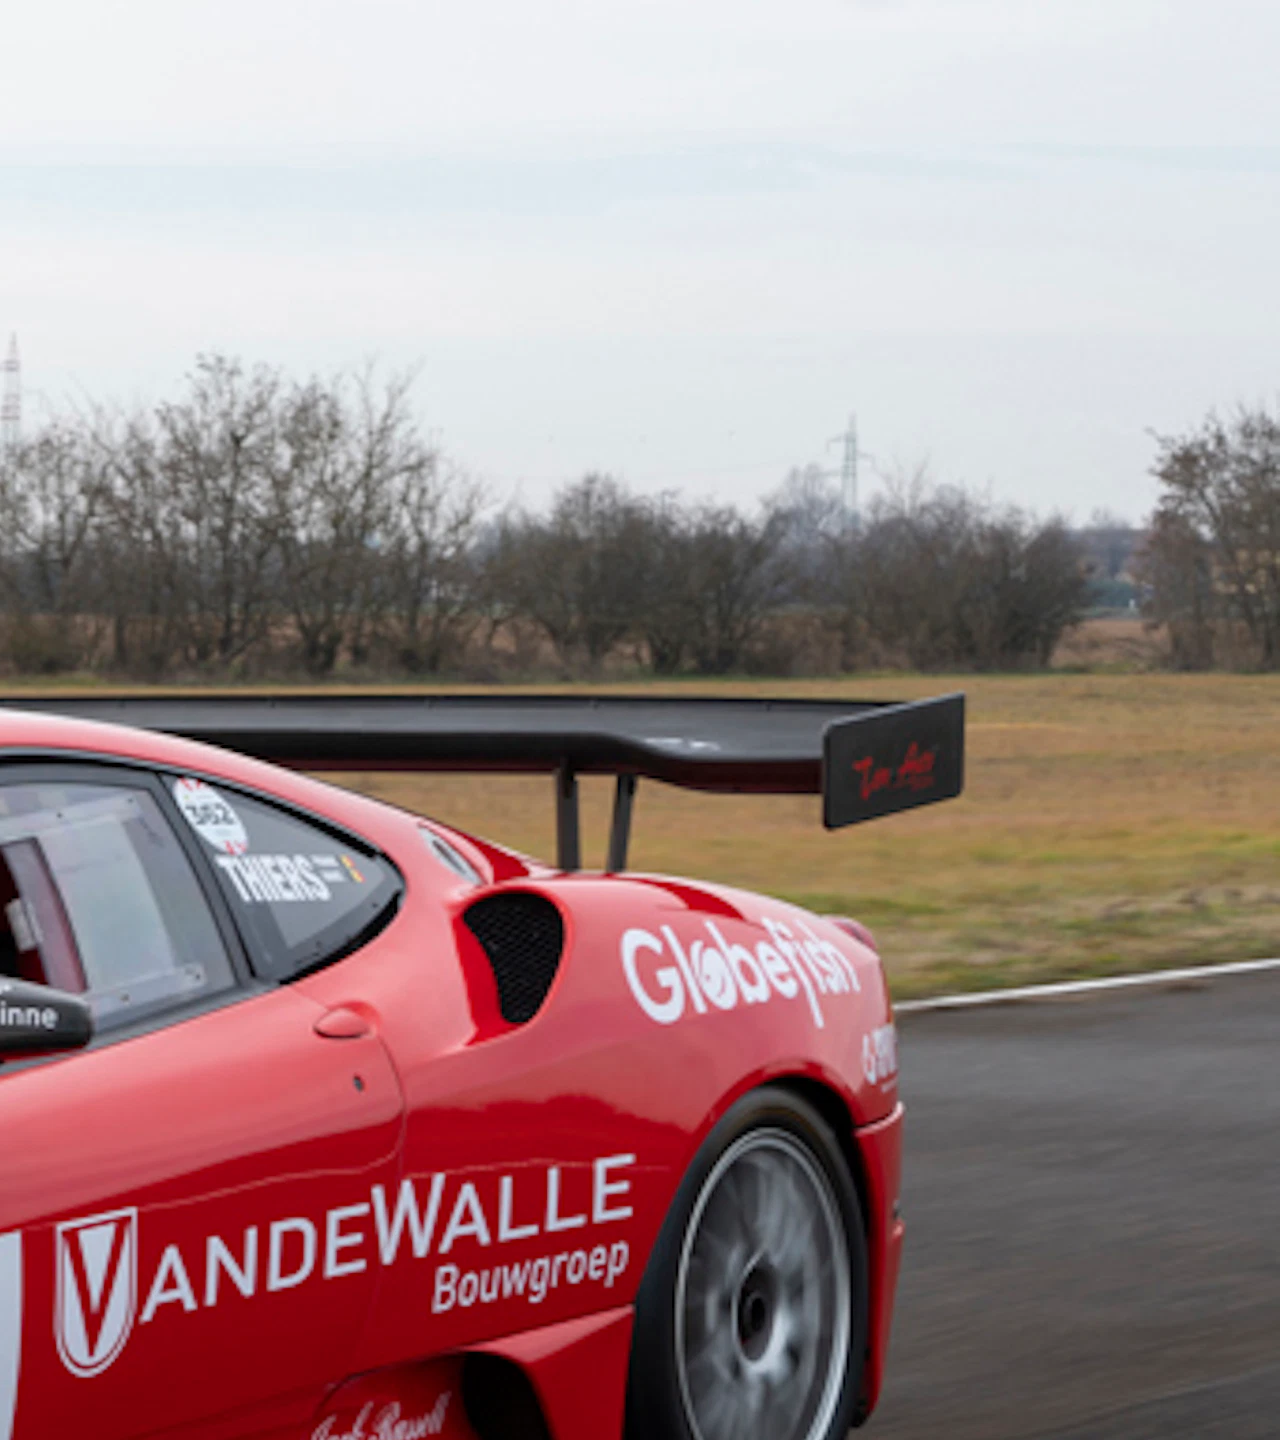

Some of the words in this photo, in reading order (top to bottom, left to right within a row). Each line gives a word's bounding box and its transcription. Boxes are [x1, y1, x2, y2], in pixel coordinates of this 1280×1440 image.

[214, 854, 332, 902] THIERS
[620, 917, 861, 1029] Globefish
[432, 1239, 629, 1313] Bouwgroep
